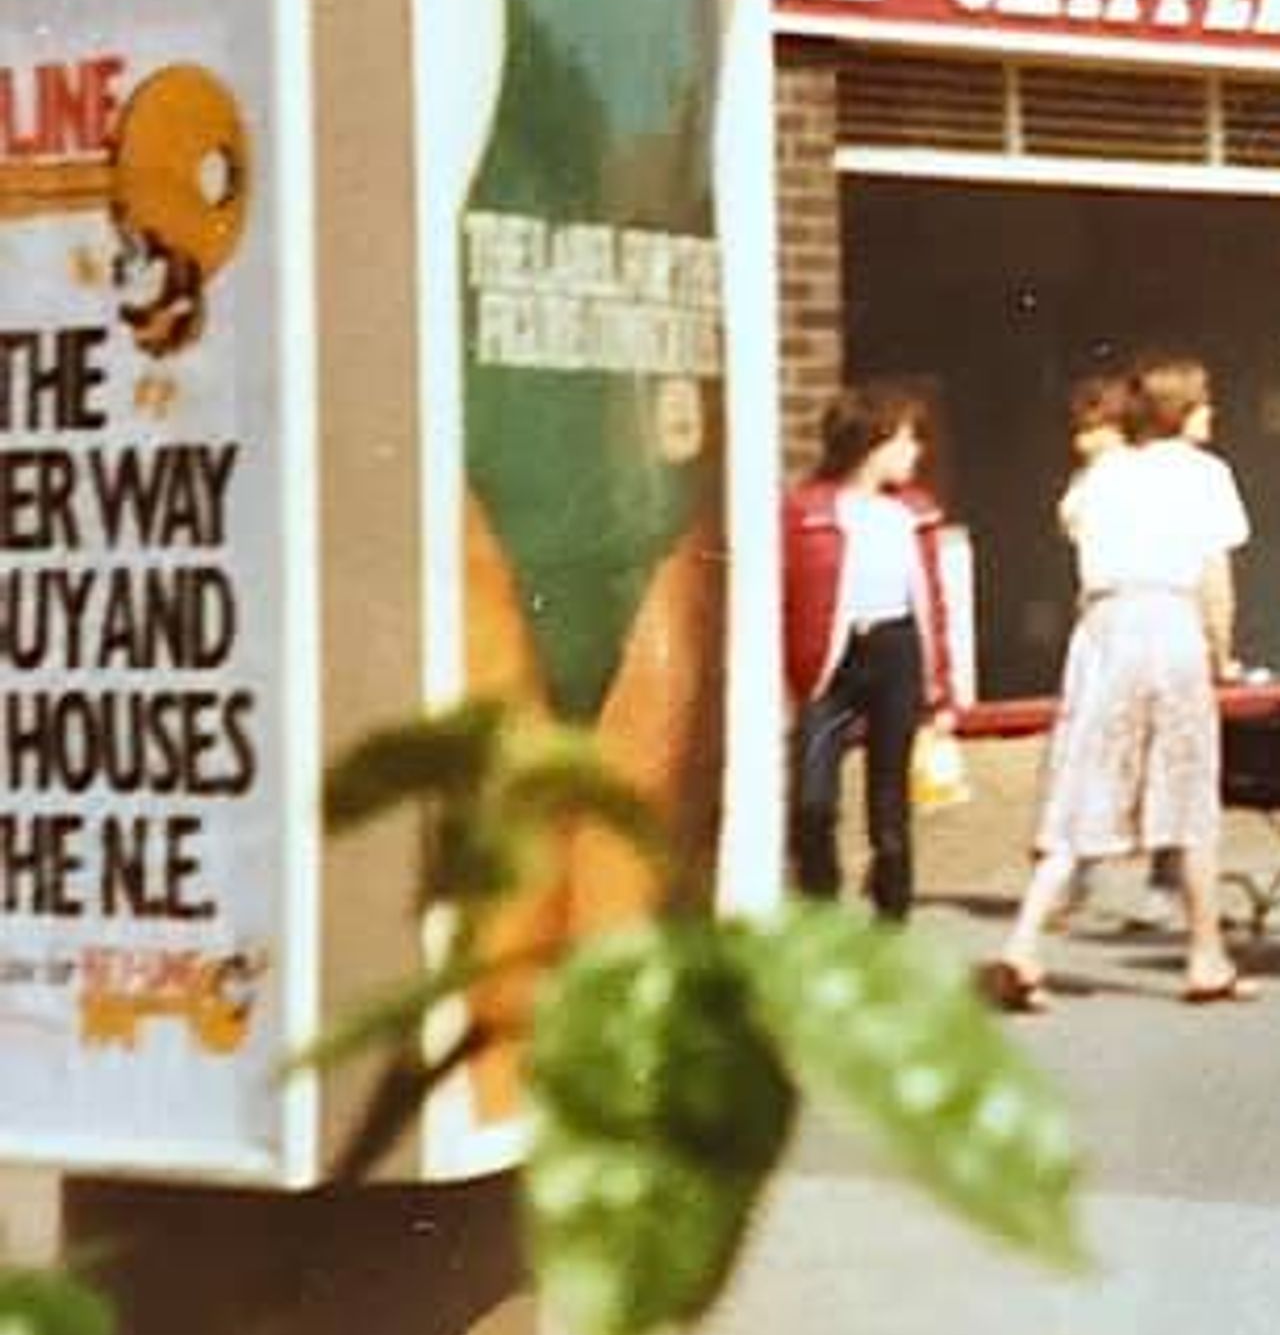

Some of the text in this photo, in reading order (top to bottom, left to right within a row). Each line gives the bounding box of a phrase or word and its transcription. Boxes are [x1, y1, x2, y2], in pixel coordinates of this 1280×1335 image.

[90, 442, 239, 549] WAY
[0, 566, 236, 671] UY AND
[6, 688, 257, 797] HOUSES
[101, 815, 216, 921] N.E.
